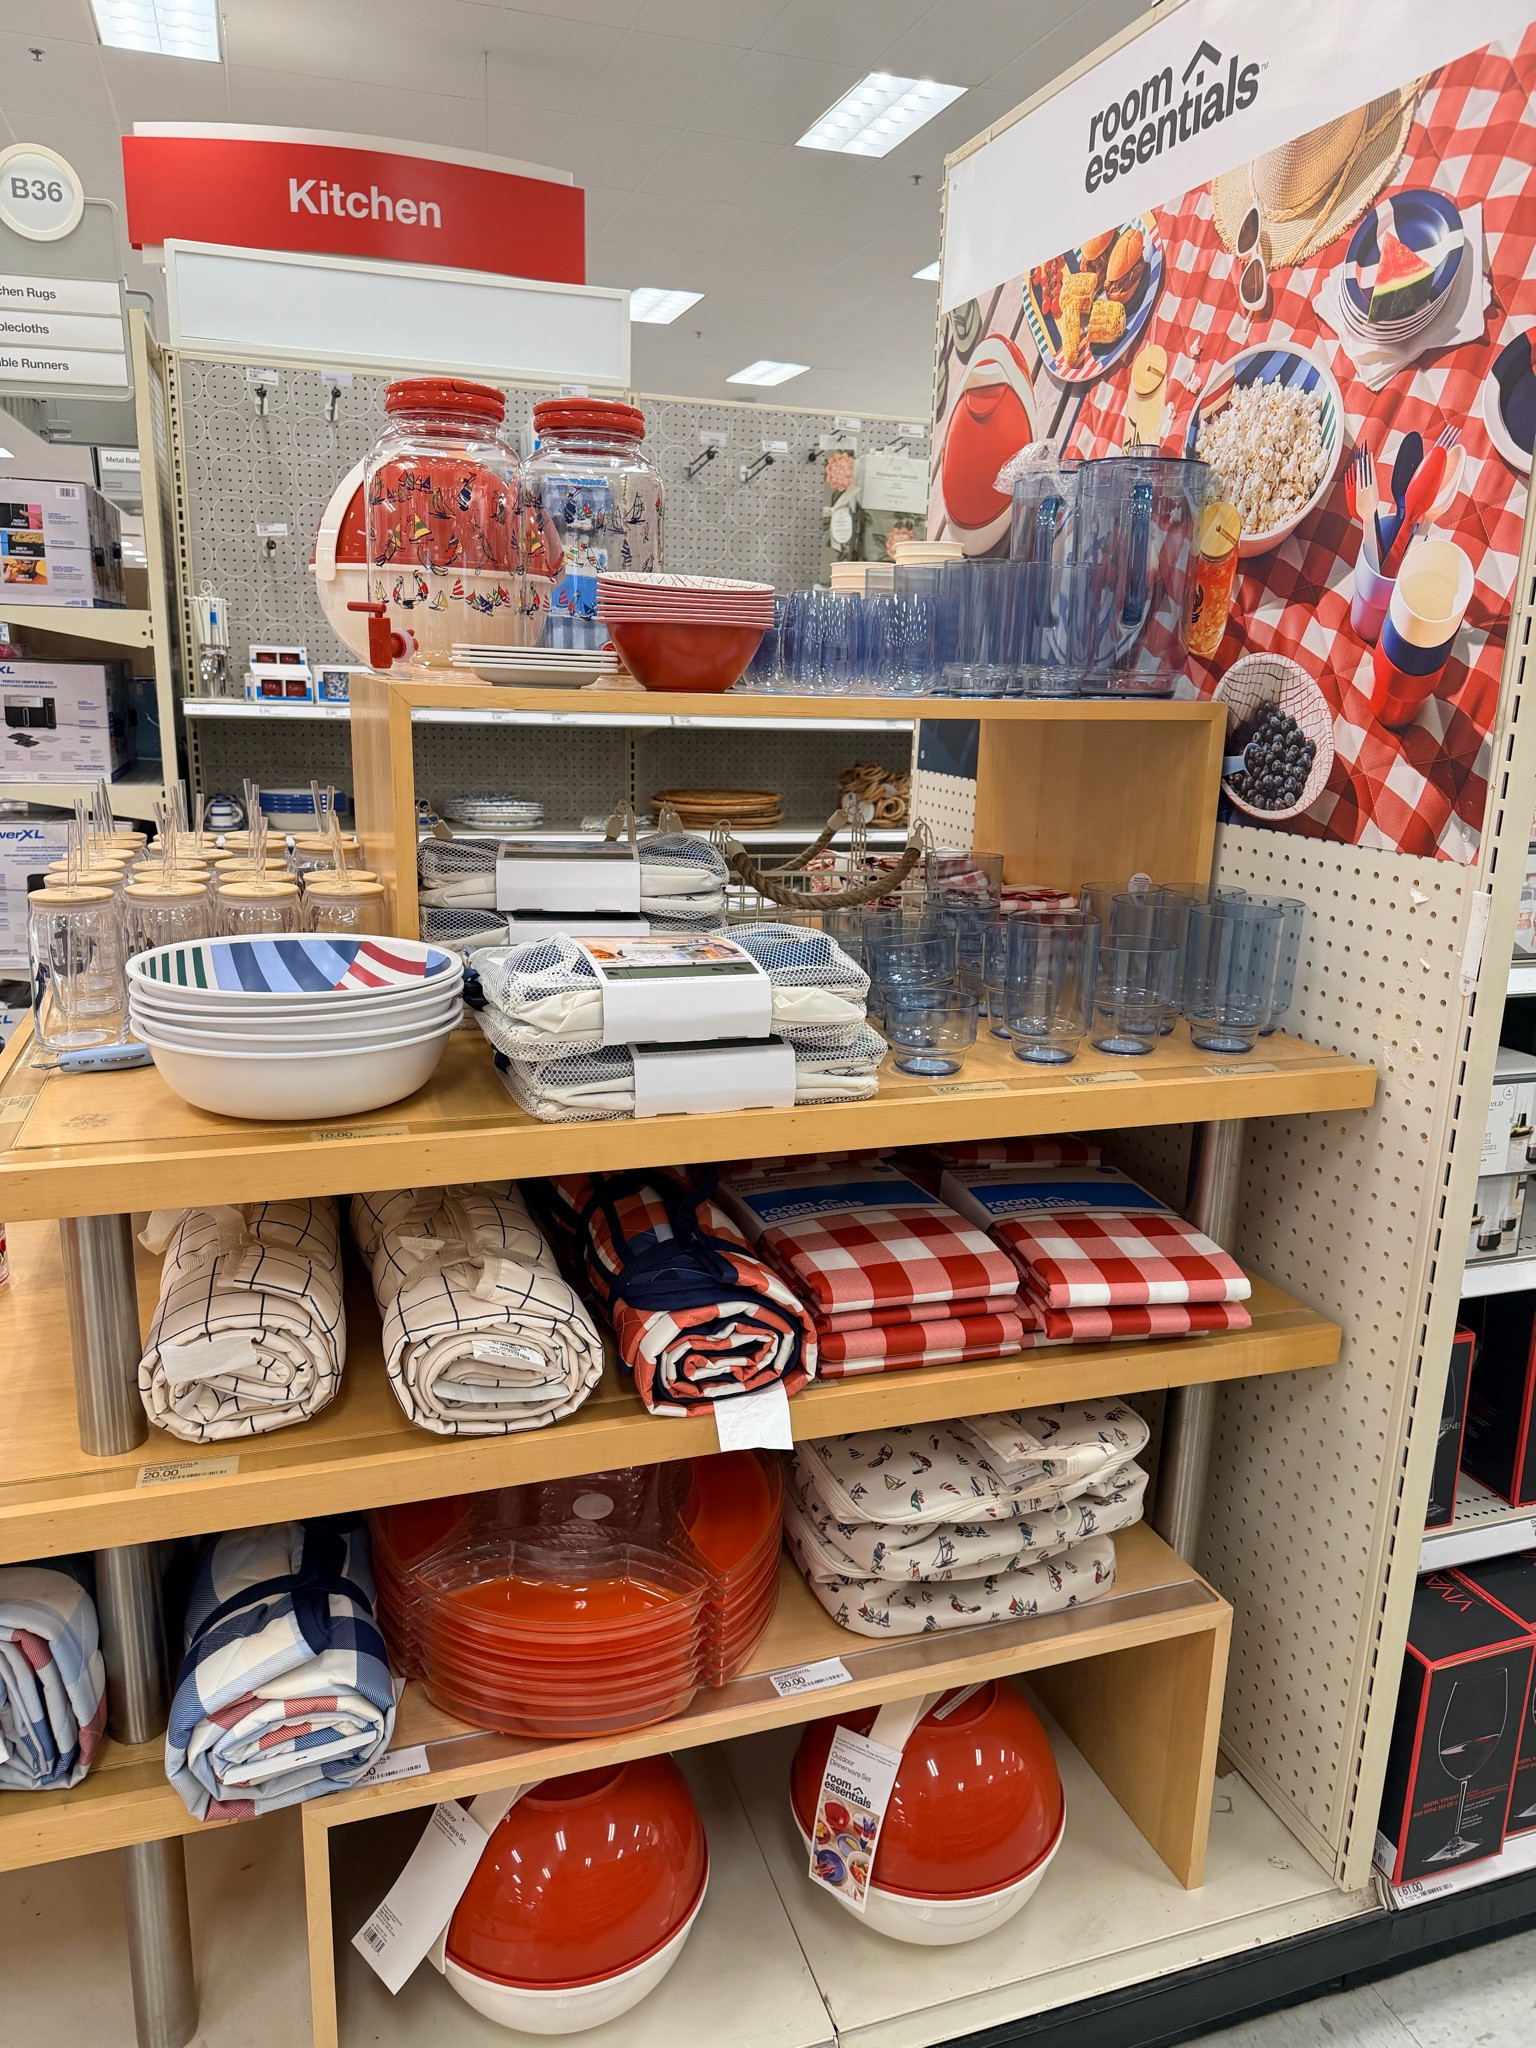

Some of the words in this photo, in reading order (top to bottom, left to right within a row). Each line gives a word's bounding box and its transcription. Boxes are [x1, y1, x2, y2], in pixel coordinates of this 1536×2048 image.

[1089, 66, 1173, 153] room
[1085, 54, 1260, 194] essentials
[11, 177, 64, 203] B36
[289, 178, 442, 228] Kitchen
[26, 287, 57, 301] Rugs
[0, 357, 19, 368] ble
[21, 358, 69, 371] Runners
[105, 456, 125, 464] Metal
[760, 1201, 815, 1217] room
[764, 1199, 865, 1222] essentials
[985, 1197, 1041, 1208] room
[991, 1199, 1091, 1214] essentials
[143, 1469, 179, 1480] 20.00
[778, 1676, 806, 1690] 20.00
[831, 1751, 855, 1766] Outdoor
[829, 1758, 861, 1779] Dinnerware
[861, 1773, 872, 1783] Set
[826, 1772, 852, 1790] room
[824, 1780, 872, 1809] essentials
[439, 1802, 457, 1823] Outdoor
[436, 1809, 459, 1838] Dinnerware
[458, 1833, 467, 1846] Set
[1401, 1881, 1423, 1896] 61.00
